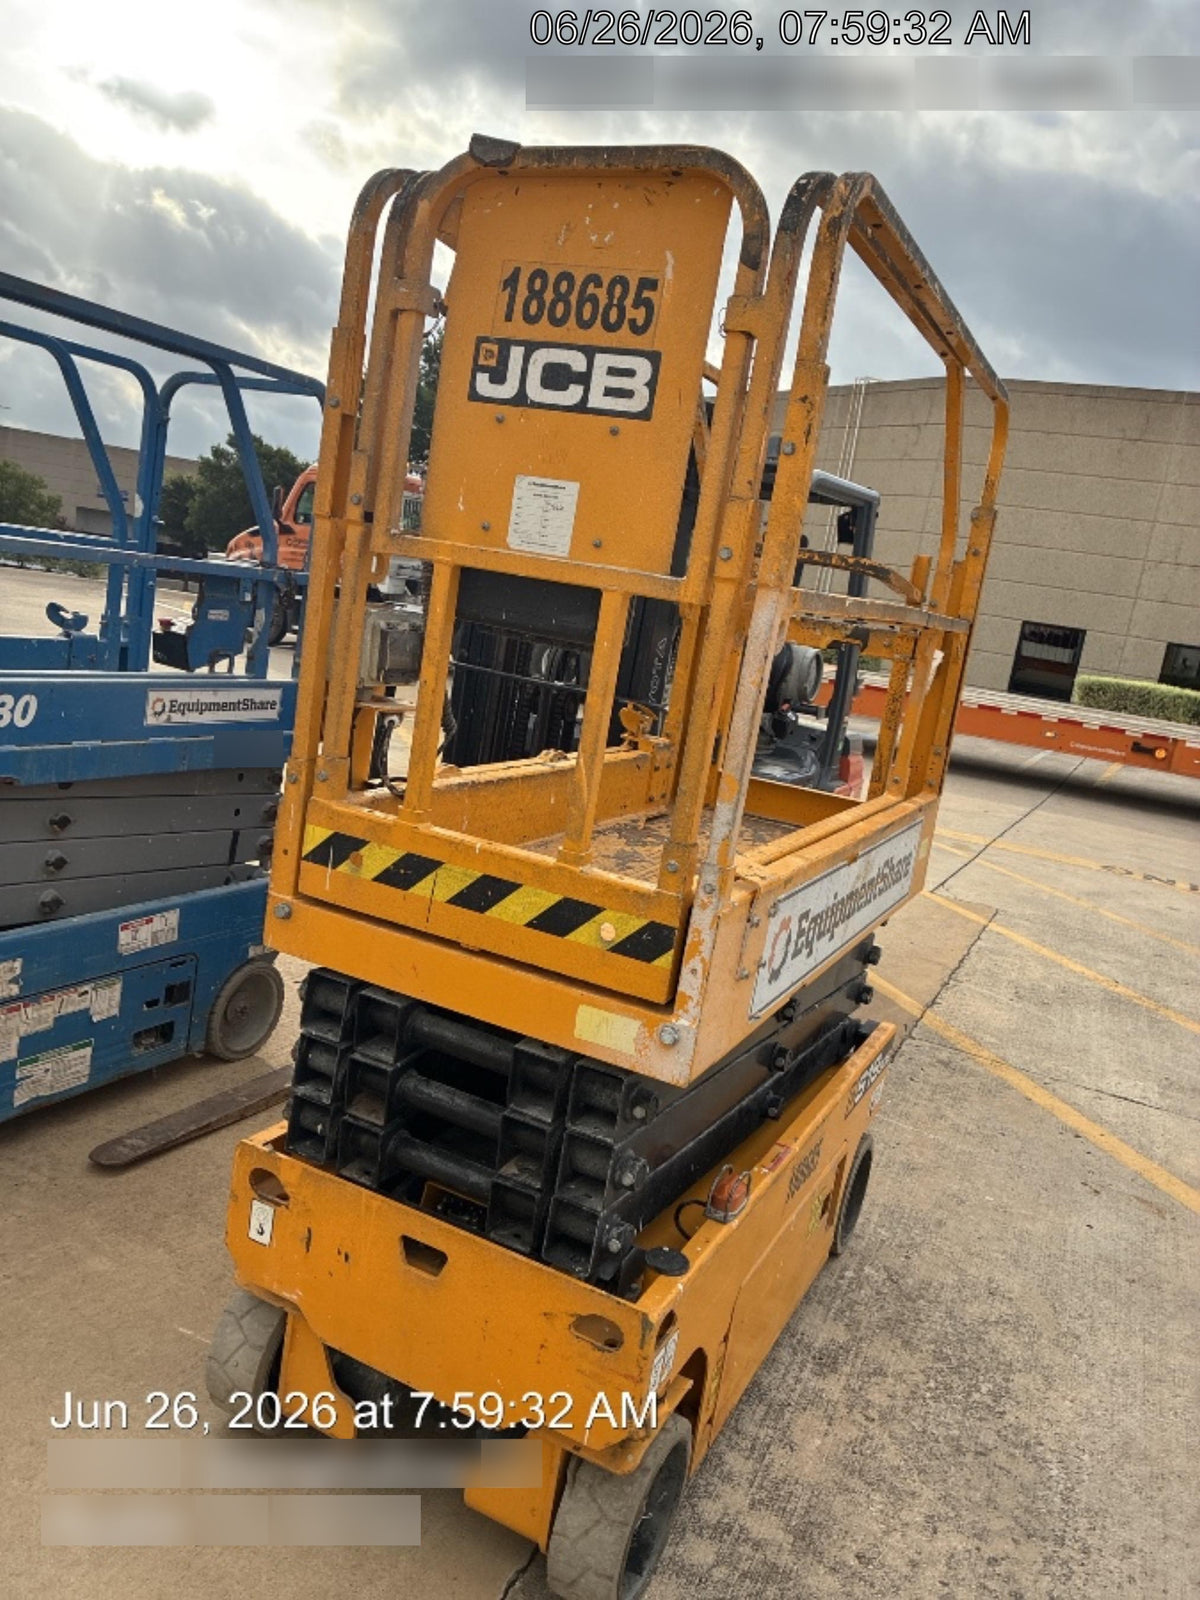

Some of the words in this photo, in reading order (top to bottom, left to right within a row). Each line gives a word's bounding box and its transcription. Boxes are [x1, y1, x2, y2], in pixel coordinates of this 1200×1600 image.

[501, 265, 660, 337] 188685
[475, 344, 654, 414] JCB
[168, 697, 278, 717] EquipmentShare
[791, 849, 913, 961] EquipmentShare
